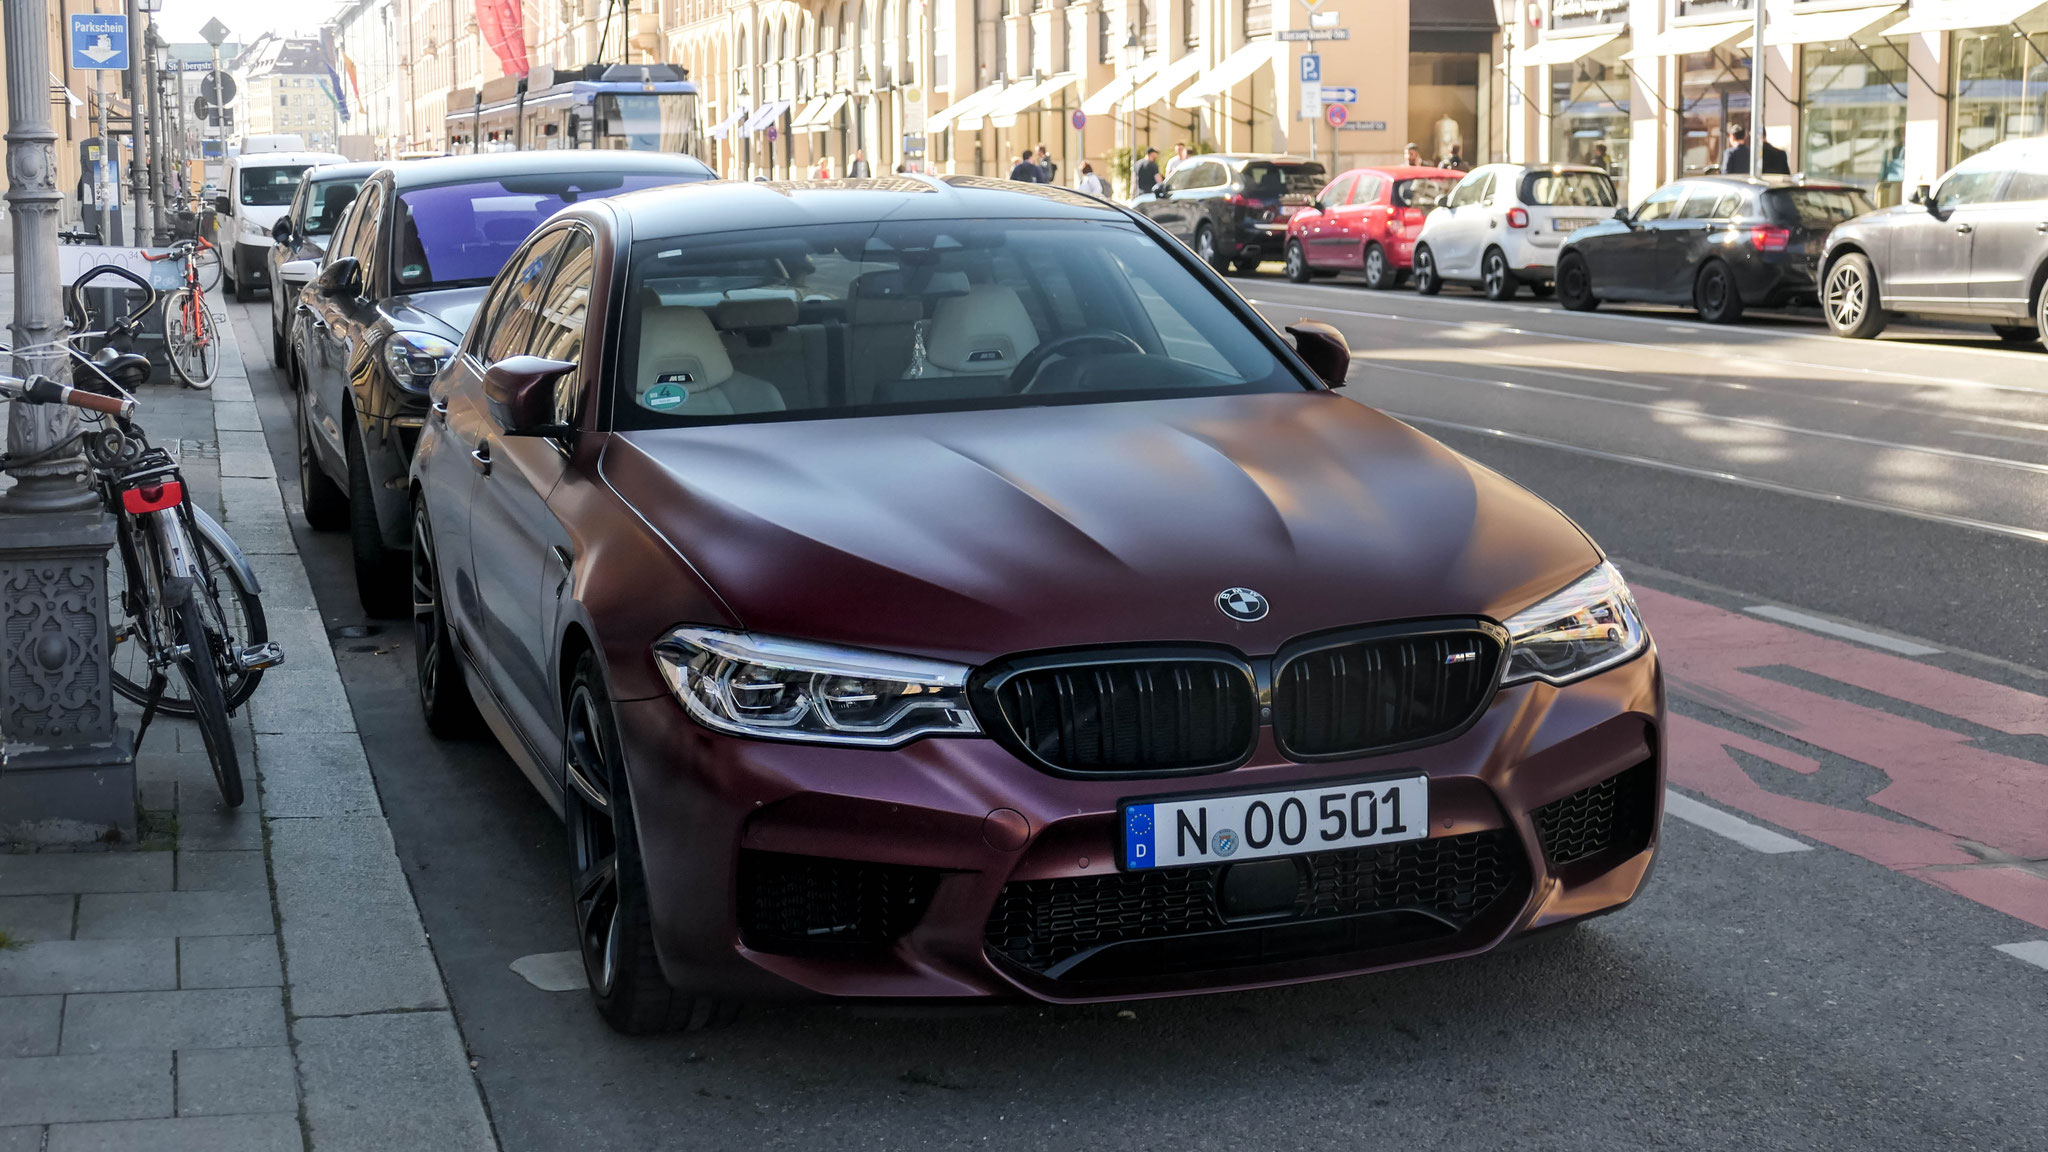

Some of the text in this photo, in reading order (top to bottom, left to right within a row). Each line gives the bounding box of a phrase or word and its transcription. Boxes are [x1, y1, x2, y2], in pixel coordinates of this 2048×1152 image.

[75, 21, 123, 32] Parkschein
[1302, 57, 1315, 79] P
[128, 251, 138, 259] 34
[154, 276, 161, 285] P
[660, 386, 671, 397] 4
[1177, 807, 1207, 857] N
[1320, 786, 1407, 842] 501
[1136, 843, 1146, 858] D
